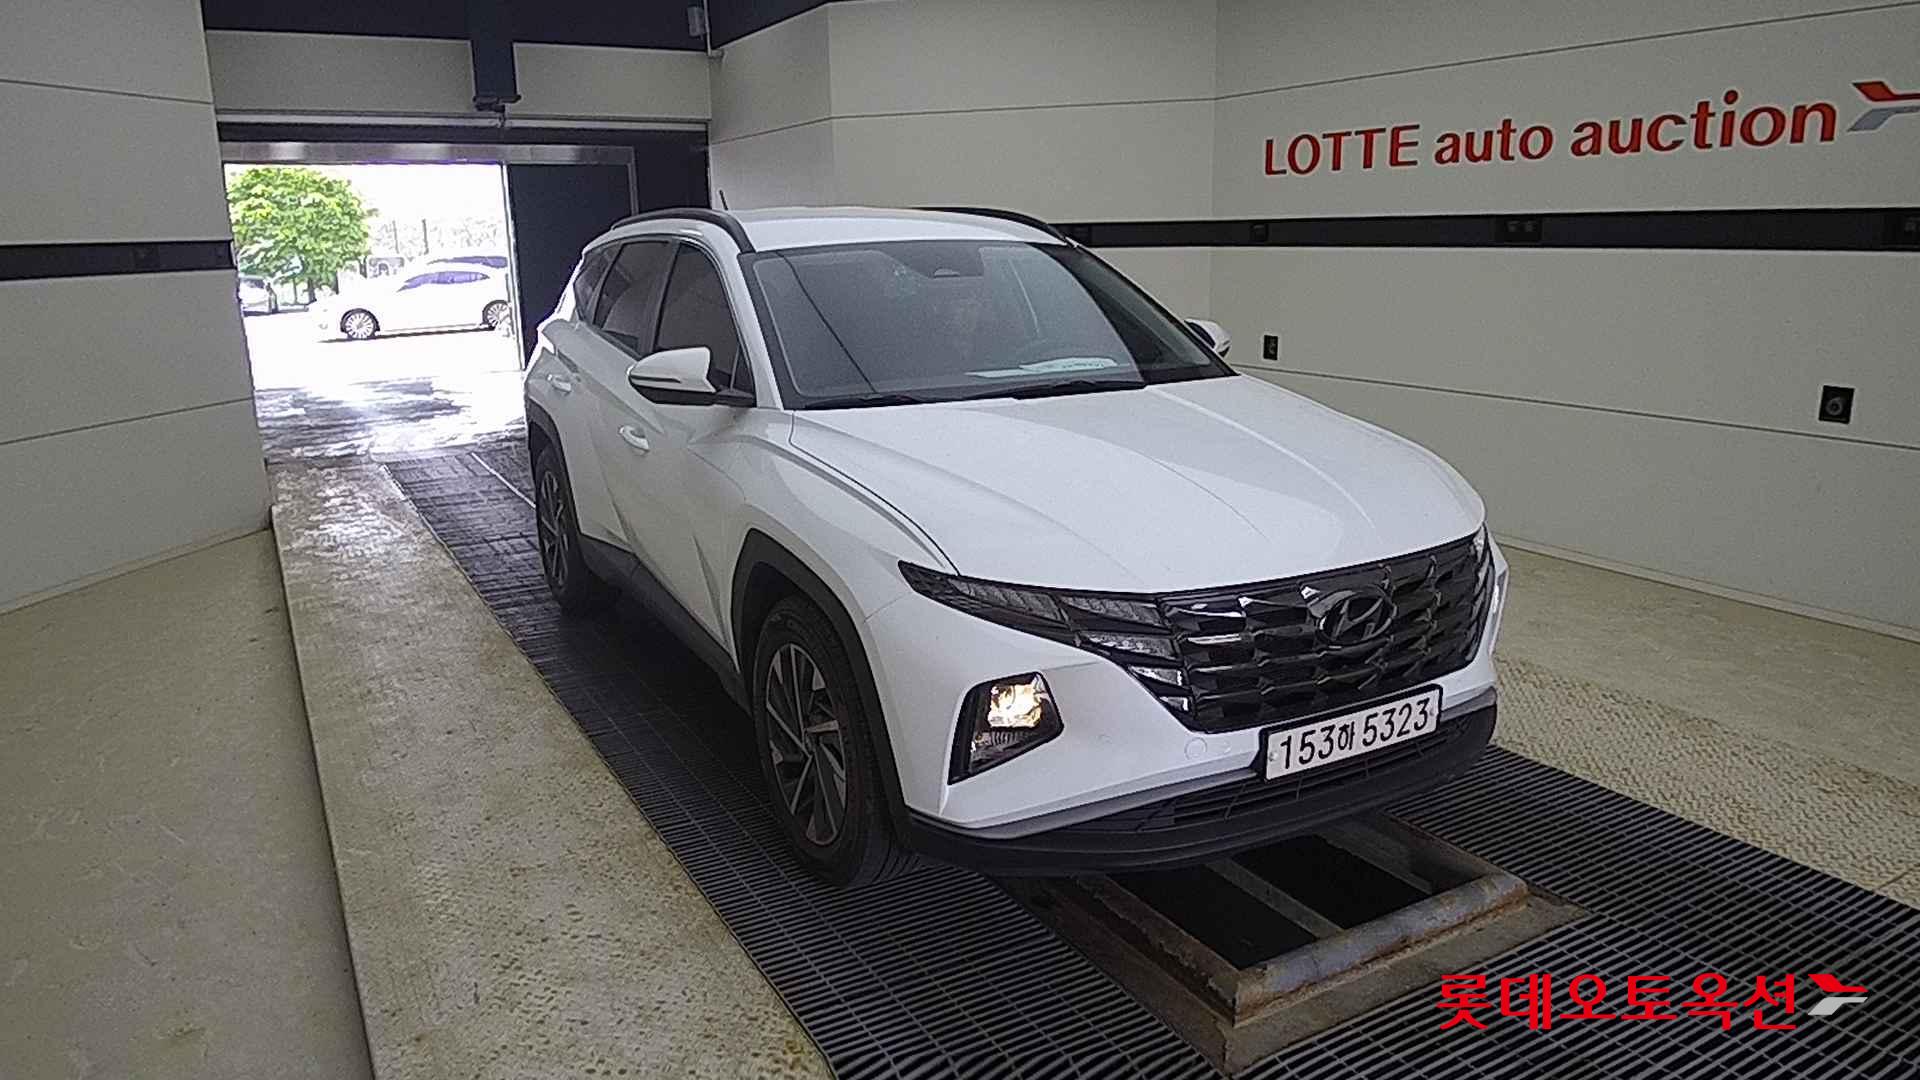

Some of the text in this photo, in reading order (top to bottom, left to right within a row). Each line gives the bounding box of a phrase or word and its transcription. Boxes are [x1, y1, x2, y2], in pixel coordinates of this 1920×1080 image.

[1264, 90, 1838, 176] LOTTE auto auction
[1280, 698, 1431, 770] 153하 5323
